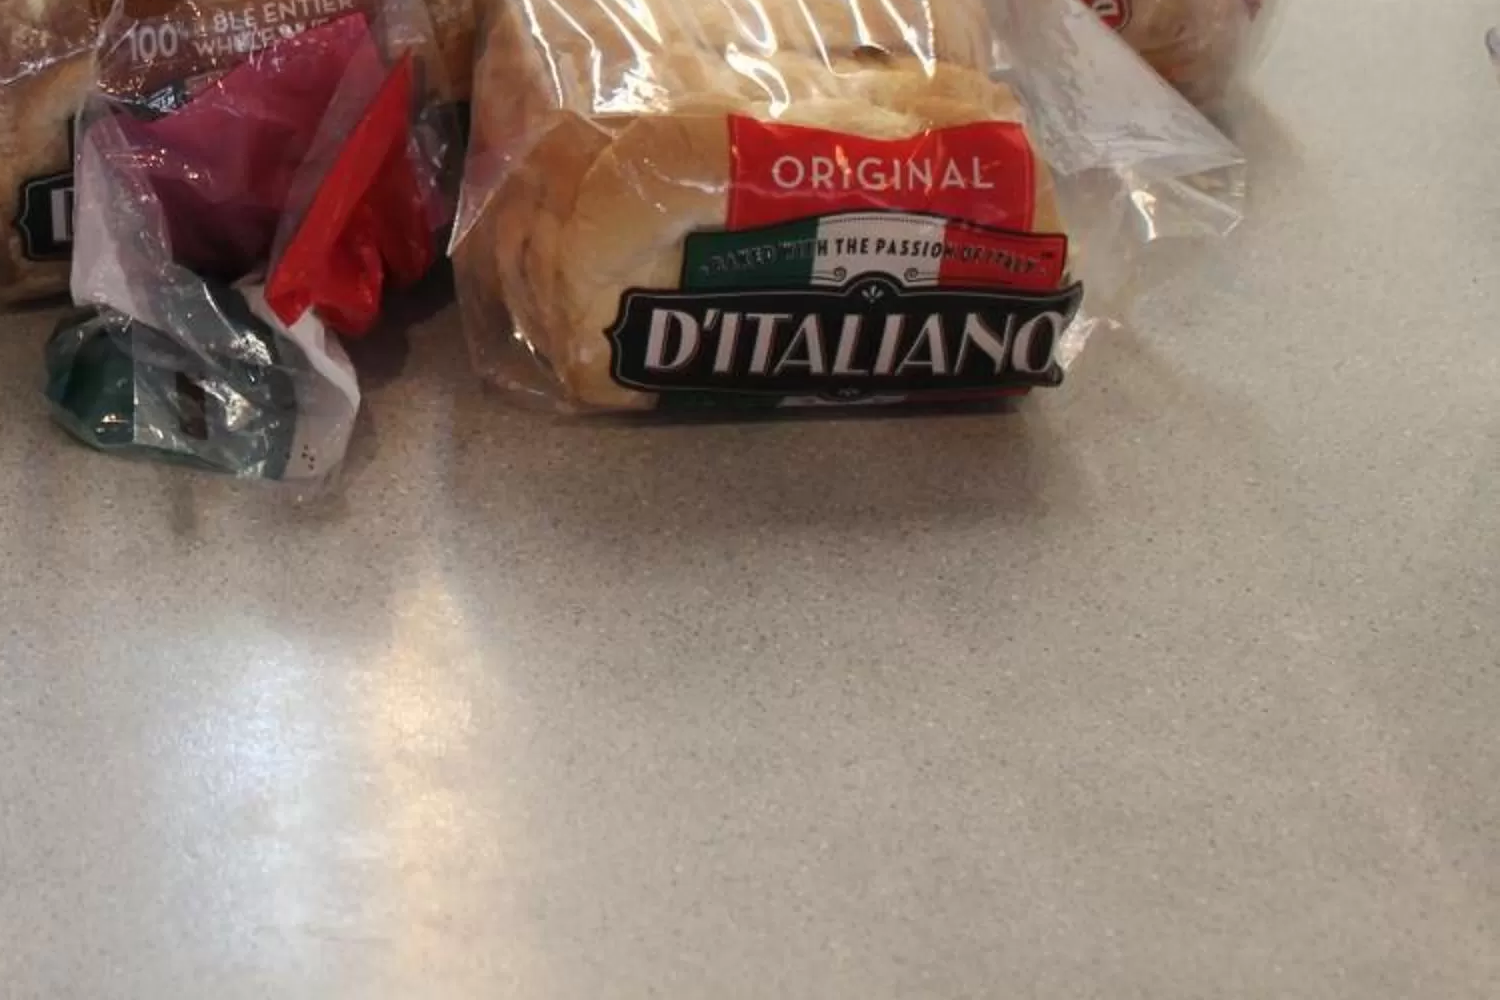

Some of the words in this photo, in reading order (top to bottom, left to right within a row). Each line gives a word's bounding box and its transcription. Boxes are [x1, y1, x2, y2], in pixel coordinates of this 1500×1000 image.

[771, 155, 995, 192] ORIGINAL
[835, 238, 870, 256] THE
[875, 238, 956, 259] PASSION
[642, 306, 1069, 377] D'ITALIANO
